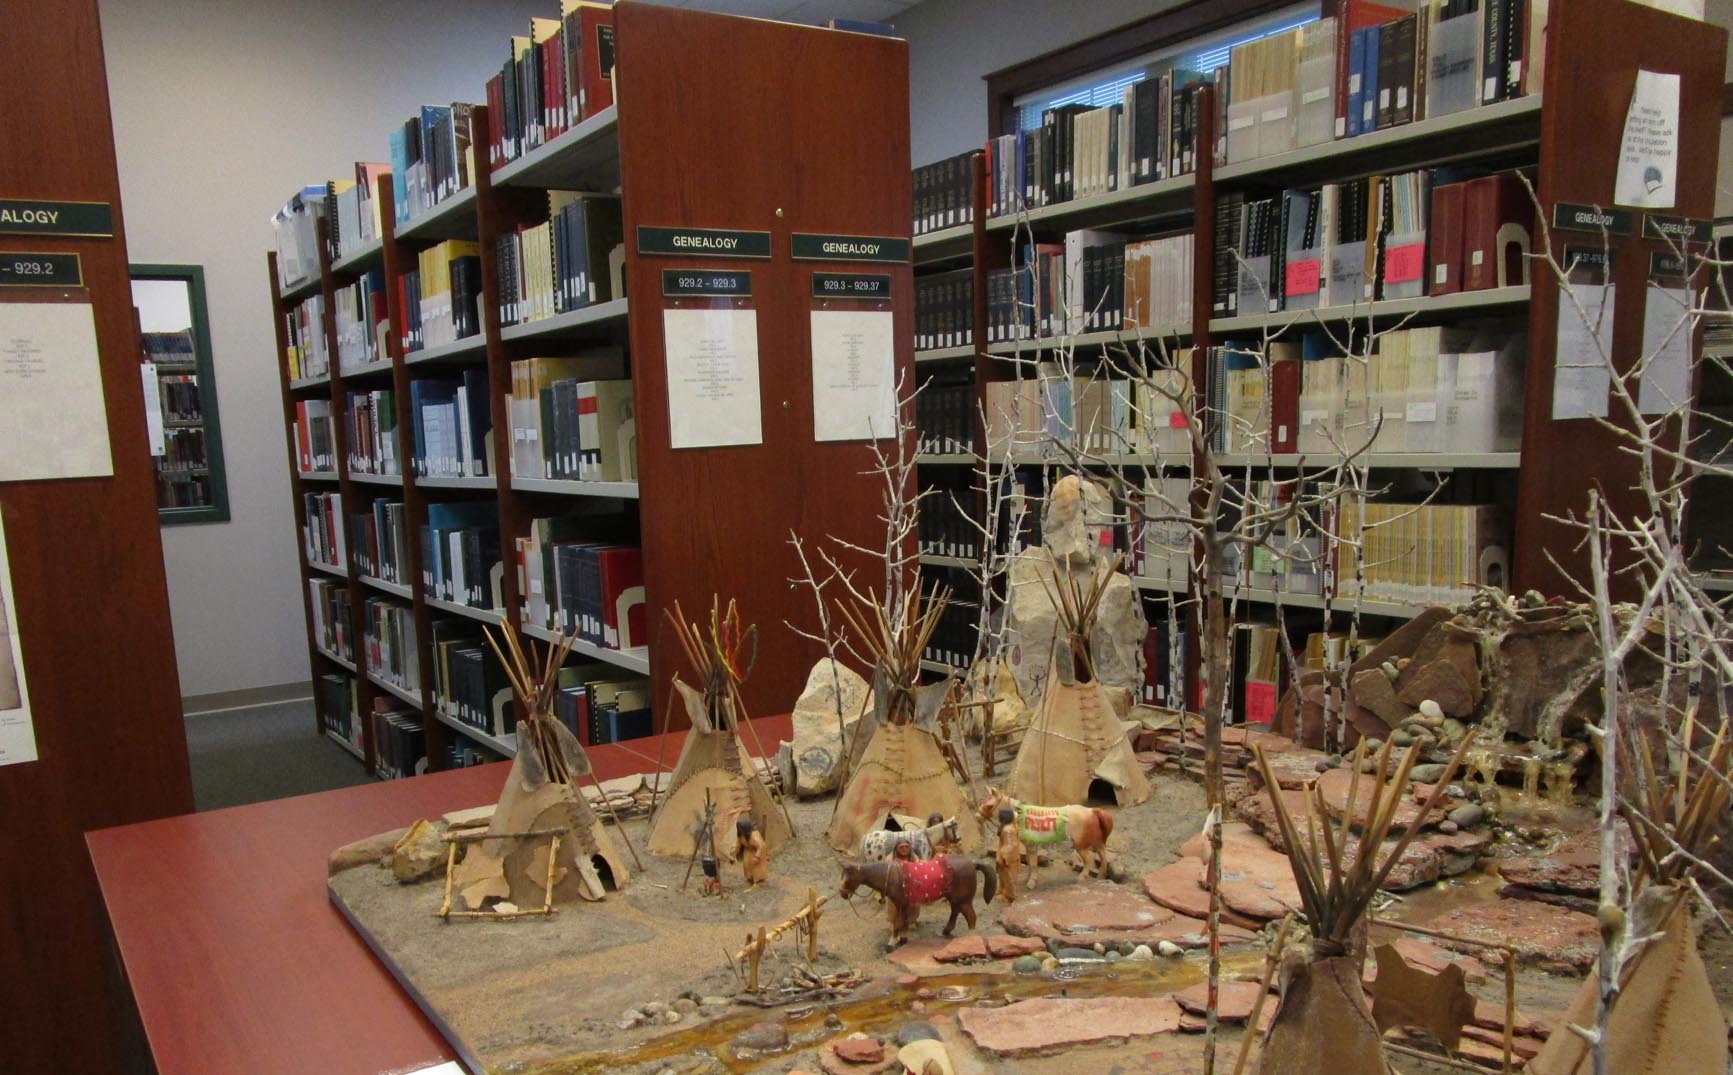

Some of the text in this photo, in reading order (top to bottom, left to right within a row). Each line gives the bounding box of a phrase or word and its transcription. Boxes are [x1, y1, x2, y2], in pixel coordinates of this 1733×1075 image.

[1, 209, 59, 224] ALOGY
[672, 235, 738, 249] GENEALOGY
[822, 242, 880, 255] GENEALOGY
[14, 262, 54, 275] 929.2
[678, 277, 703, 289] 929.2
[712, 278, 737, 289] 929.3
[824, 280, 846, 290] 929.3
[854, 281, 880, 291] 929.37
